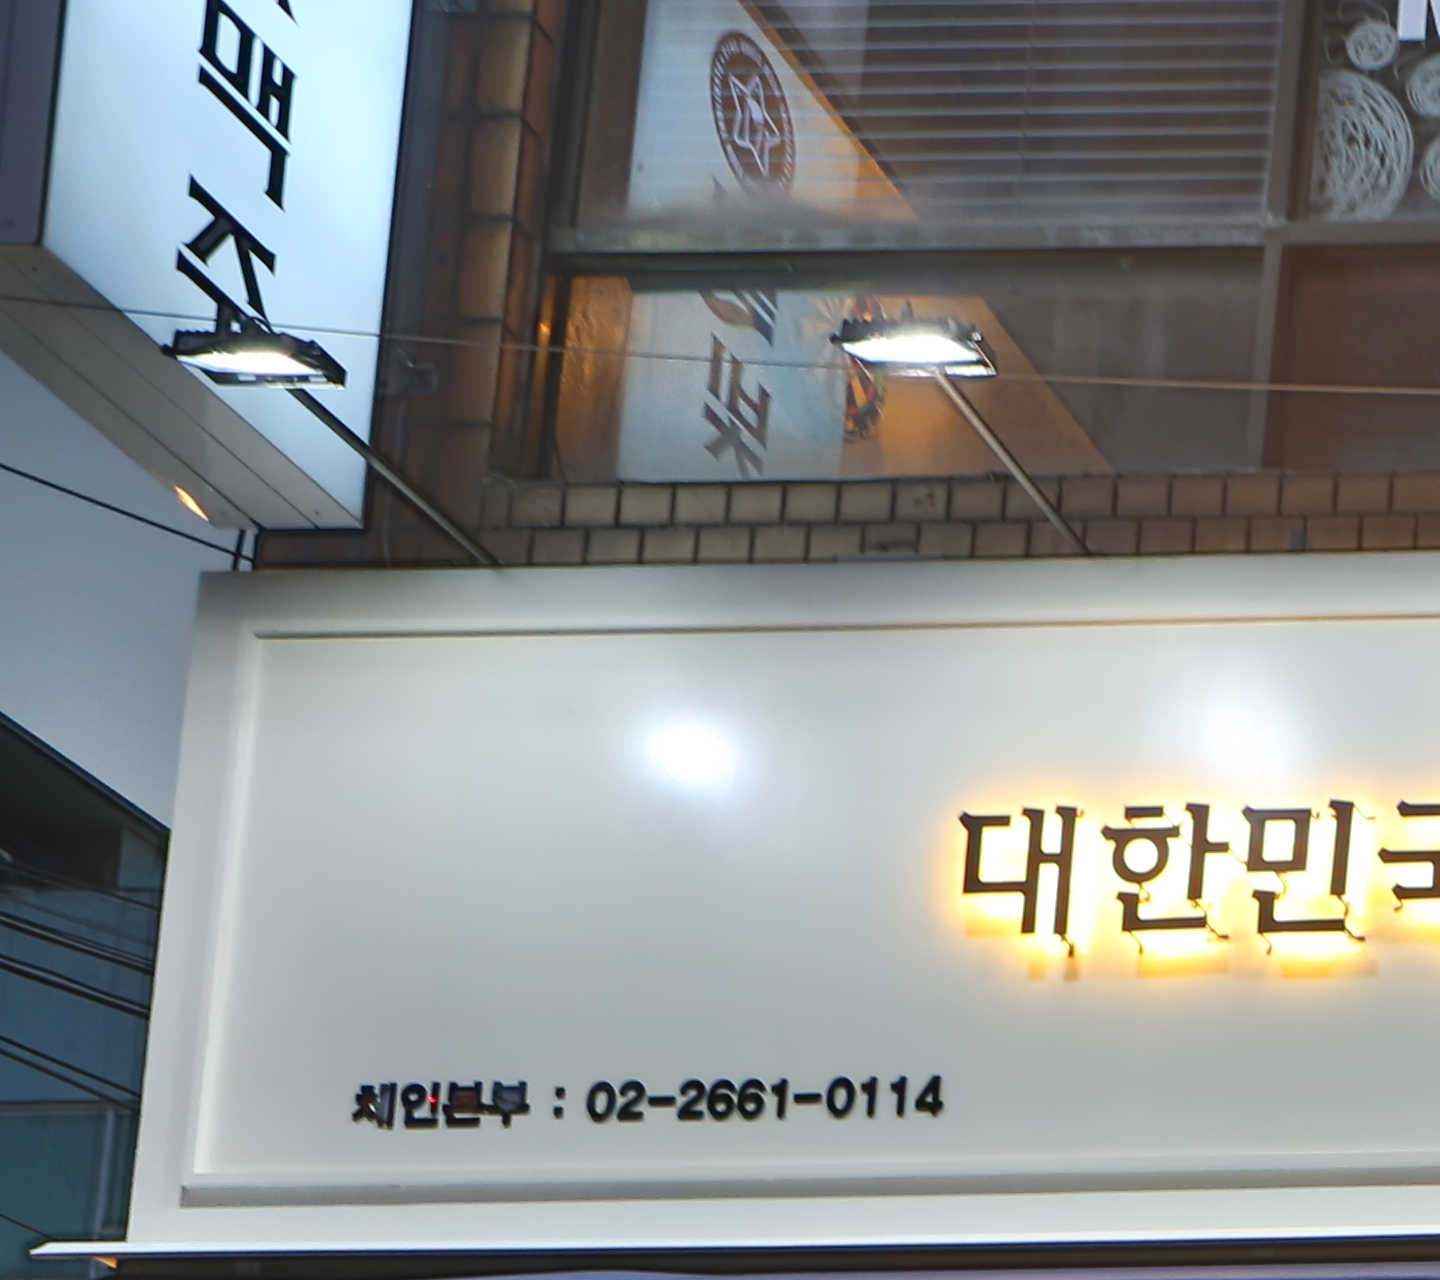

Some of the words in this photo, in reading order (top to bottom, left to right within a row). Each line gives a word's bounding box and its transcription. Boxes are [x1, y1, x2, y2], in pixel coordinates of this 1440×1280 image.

[177, 0, 299, 338] 맥주
[352, 1081, 530, 1129] 체인본부
[586, 1076, 945, 1121] 02-2661-0114
